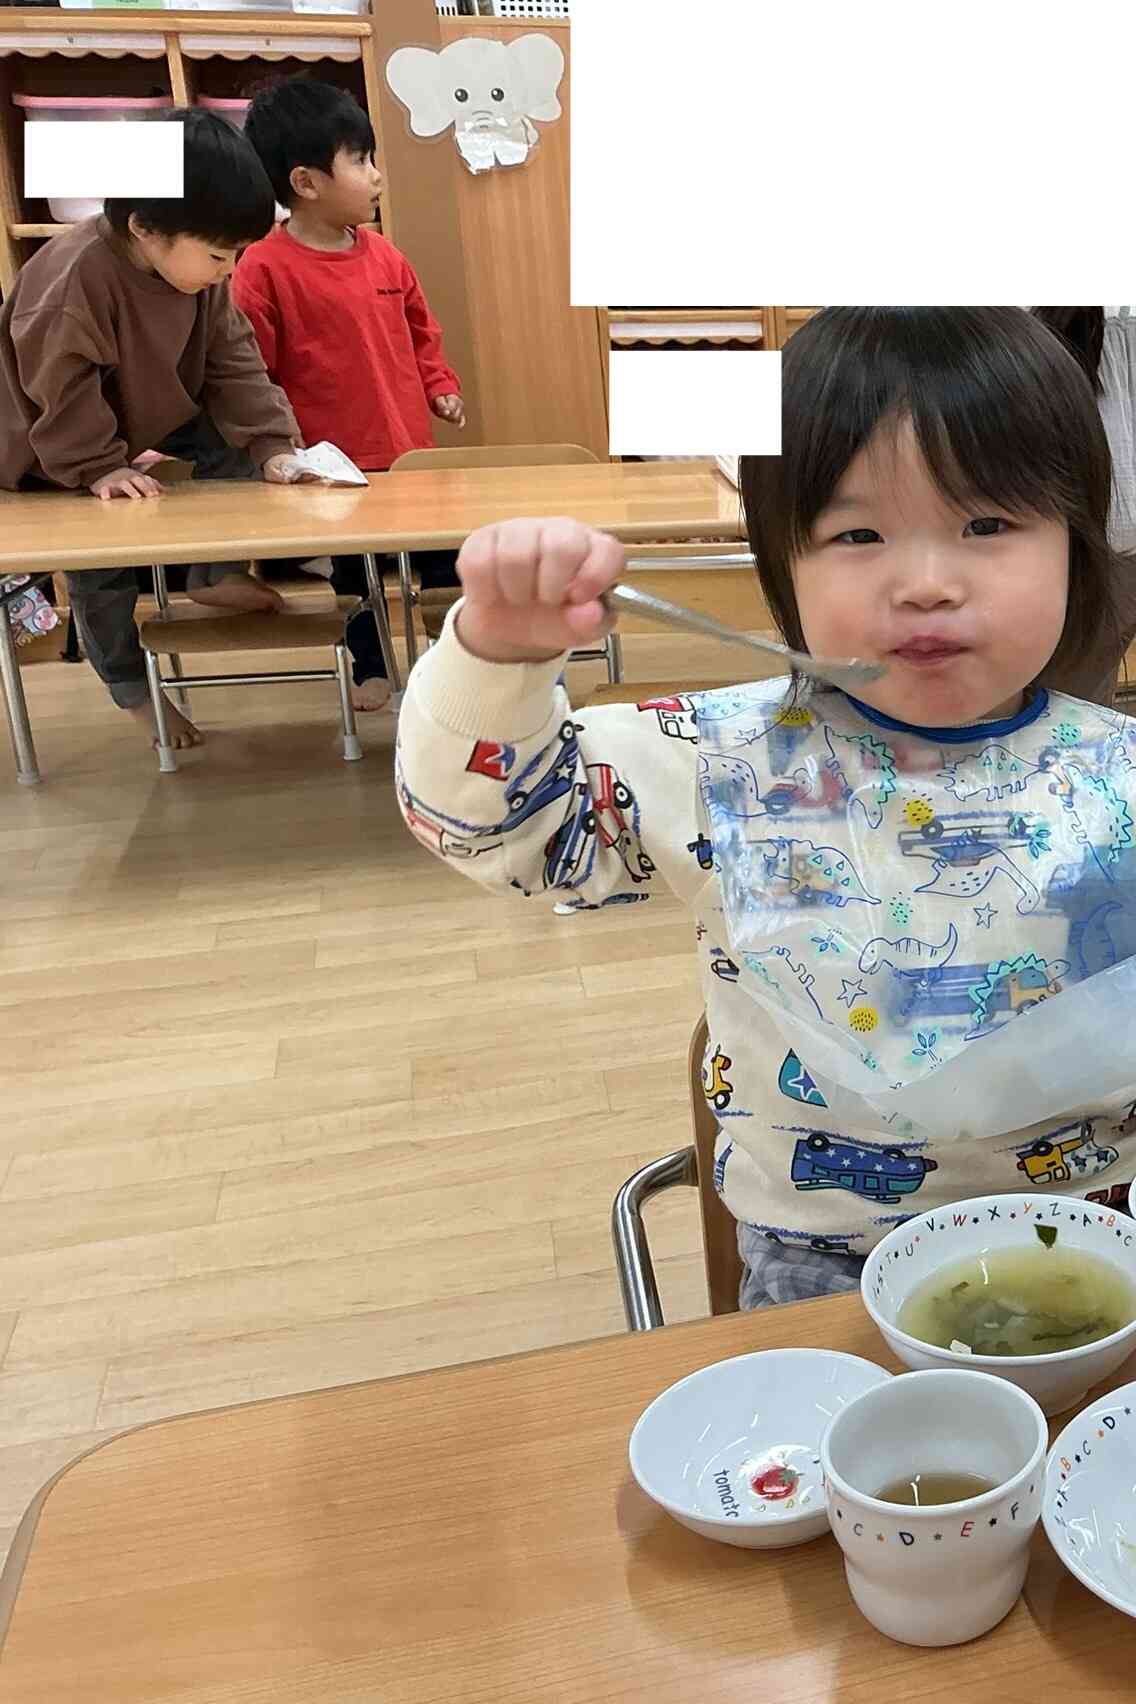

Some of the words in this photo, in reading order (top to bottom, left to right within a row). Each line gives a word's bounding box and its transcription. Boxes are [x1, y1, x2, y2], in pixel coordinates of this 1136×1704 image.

[904, 1242, 914, 1257] U
[926, 1217, 935, 1232] V
[952, 1213, 968, 1227] W
[987, 1205, 1001, 1221] X
[1024, 1201, 1033, 1215] Y
[1049, 1202, 1062, 1217] Z
[1082, 1213, 1092, 1228] A
[1106, 1214, 1116, 1228] B
[1123, 1235, 1133, 1247] C
[1059, 1456, 1073, 1472] B
[1082, 1440, 1092, 1456] C
[1102, 1416, 1117, 1430] D
[853, 1522, 865, 1537] C
[899, 1531, 915, 1546] D
[959, 1520, 975, 1538] E
[1010, 1501, 1022, 1520] F
